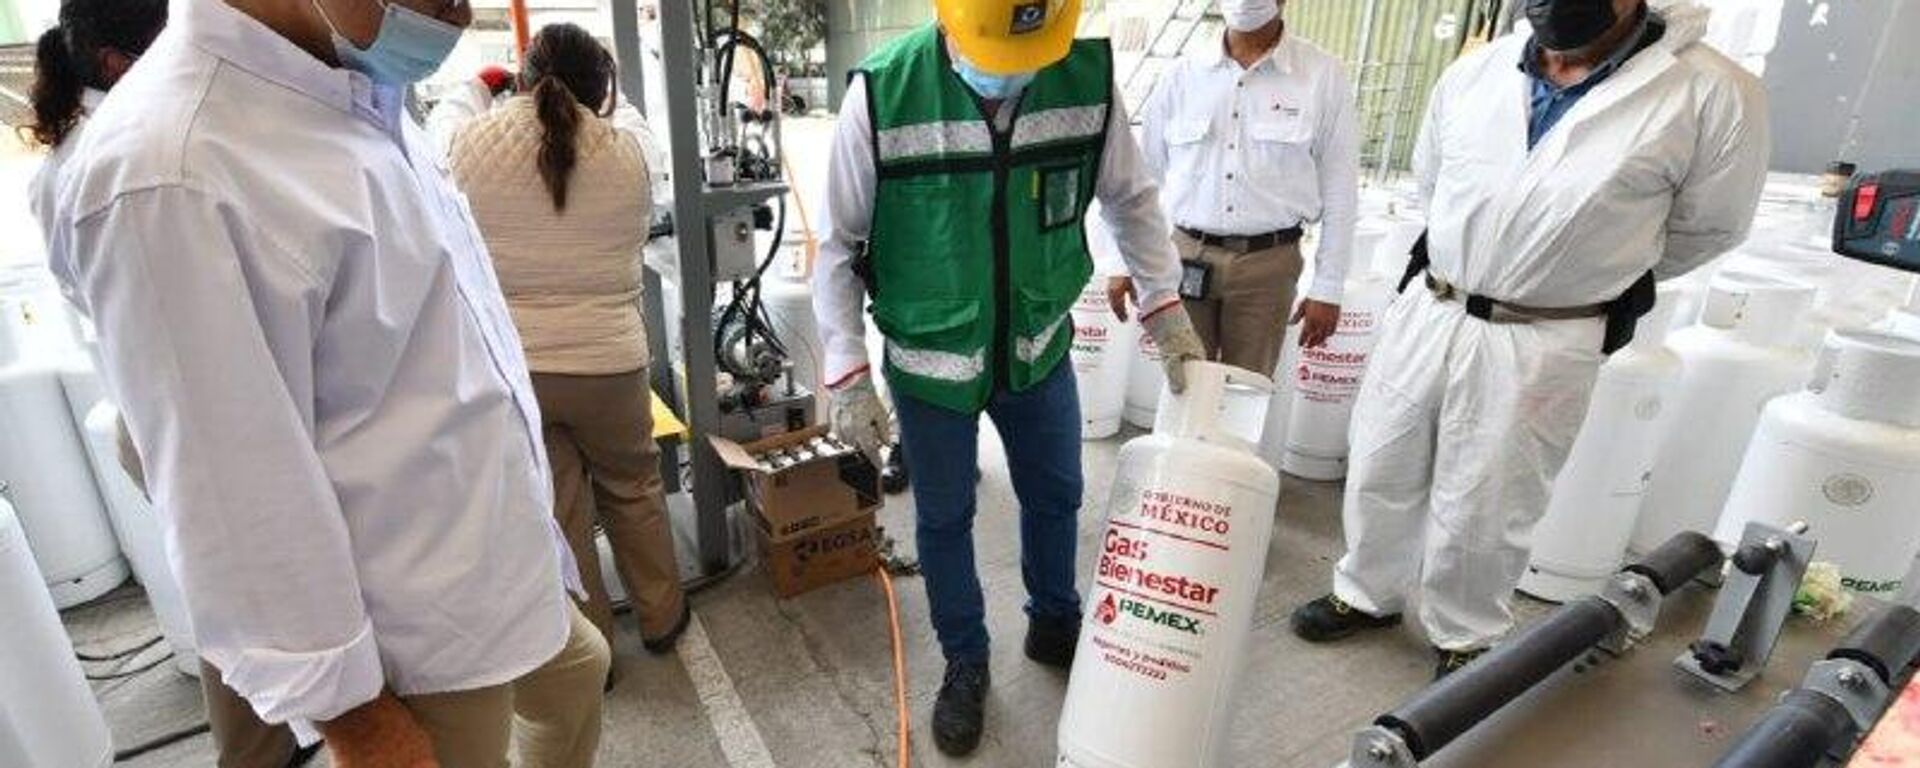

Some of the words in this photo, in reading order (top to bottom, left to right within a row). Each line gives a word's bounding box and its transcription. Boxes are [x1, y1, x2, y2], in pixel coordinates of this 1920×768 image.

[1140, 502, 1230, 535] MÉXICO
[1103, 527, 1149, 561] Gas
[1098, 554, 1220, 605] Bienestar
[1118, 598, 1201, 636] PEMEX
